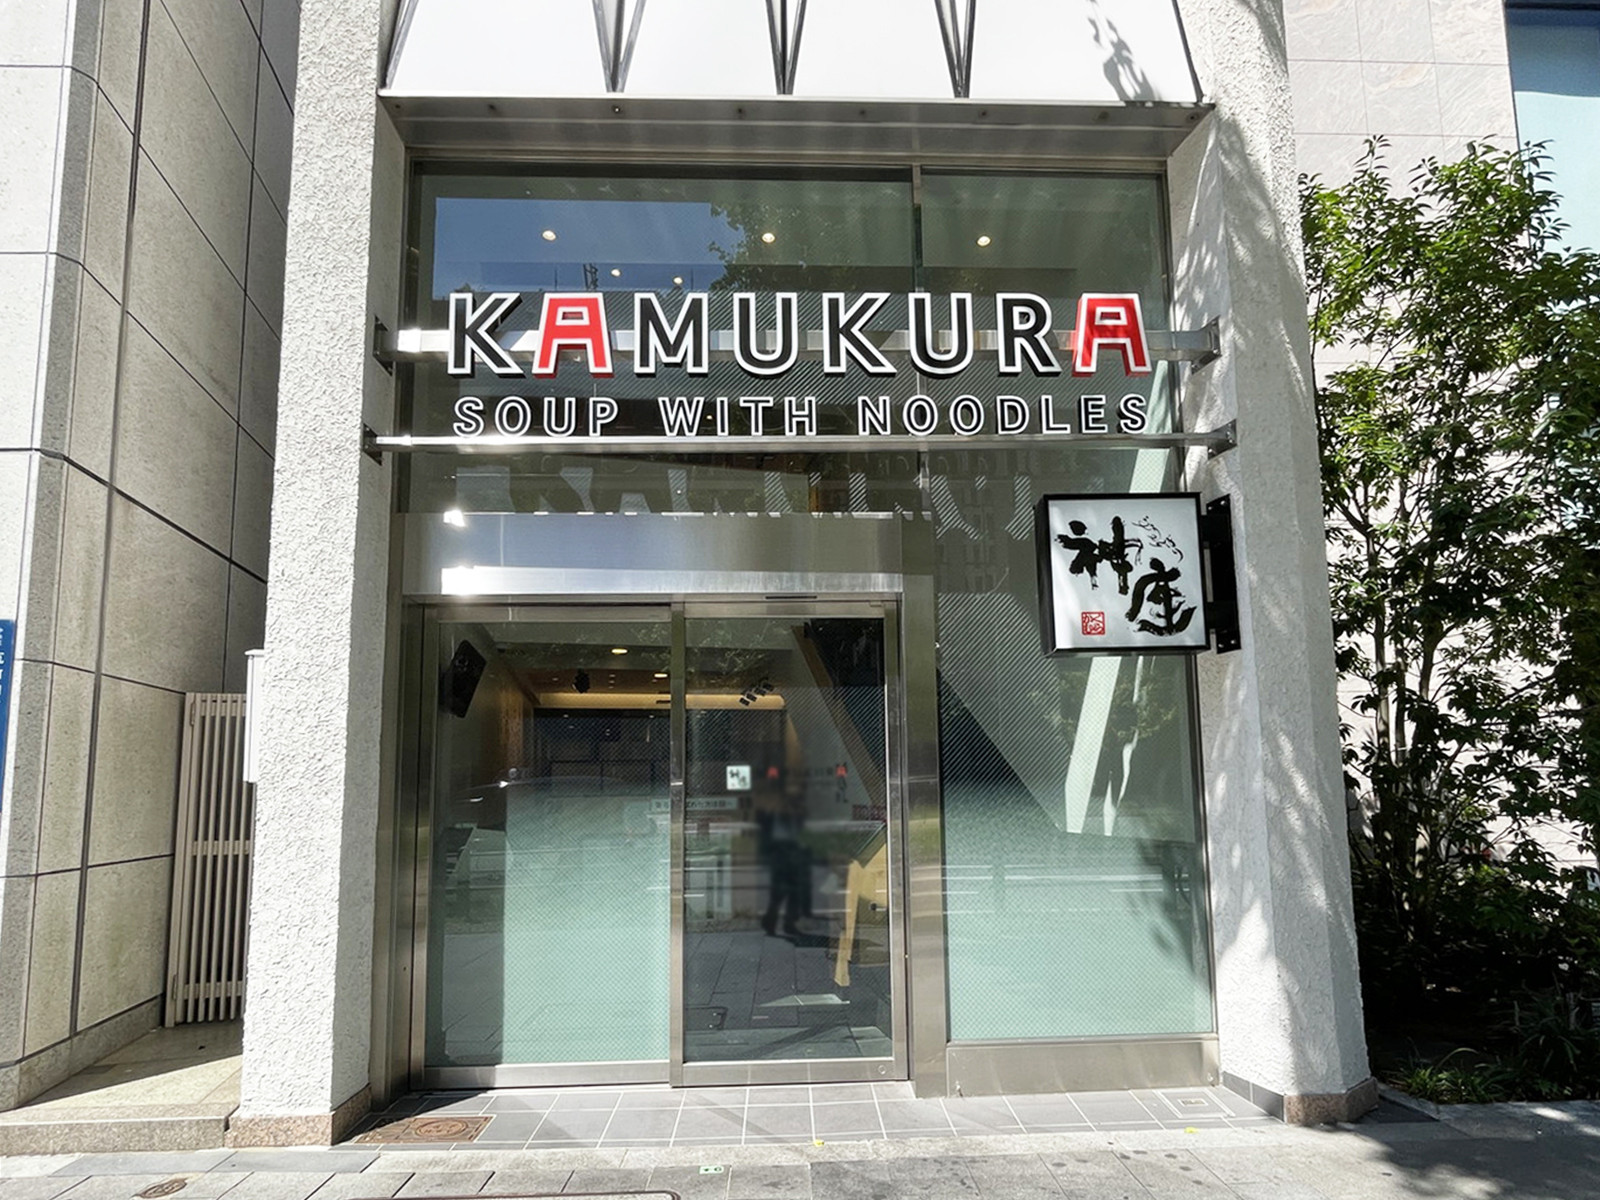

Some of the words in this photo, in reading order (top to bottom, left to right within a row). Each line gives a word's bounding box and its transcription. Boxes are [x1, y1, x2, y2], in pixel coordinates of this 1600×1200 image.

[447, 292, 1152, 376] KAMUKURA
[453, 396, 618, 438] SOUP
[658, 396, 817, 436] WITH
[857, 394, 1148, 436] NOODLES
[1055, 515, 1197, 636] 神座
